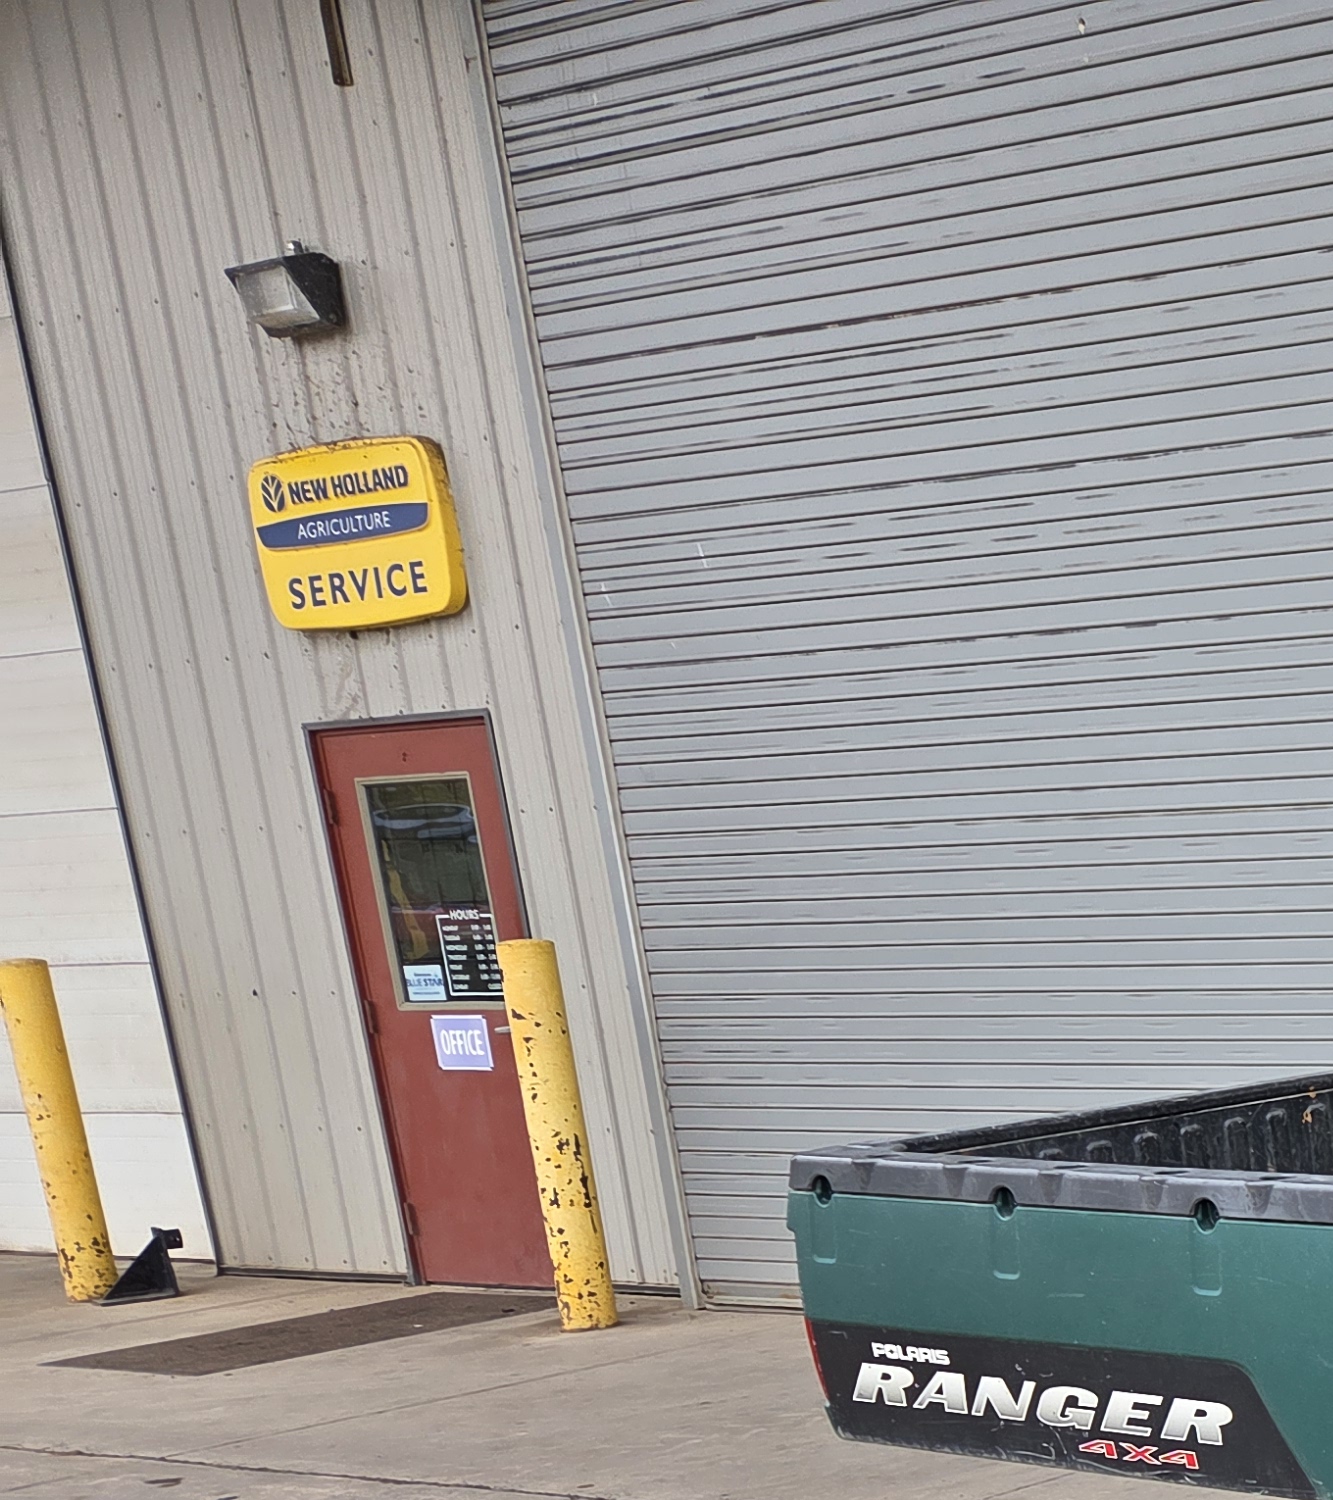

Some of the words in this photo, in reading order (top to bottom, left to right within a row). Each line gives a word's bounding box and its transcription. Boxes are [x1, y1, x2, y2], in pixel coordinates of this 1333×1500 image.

[287, 475, 328, 505] NEW
[331, 464, 409, 497] HOLLAND
[297, 511, 391, 540] AGRICULTURE
[288, 560, 429, 610] SERVICE
[449, 909, 480, 920] HOURS
[440, 1029, 485, 1056] OFFICE
[871, 1341, 950, 1366] POLARIS
[852, 1362, 1234, 1446] RANGER
